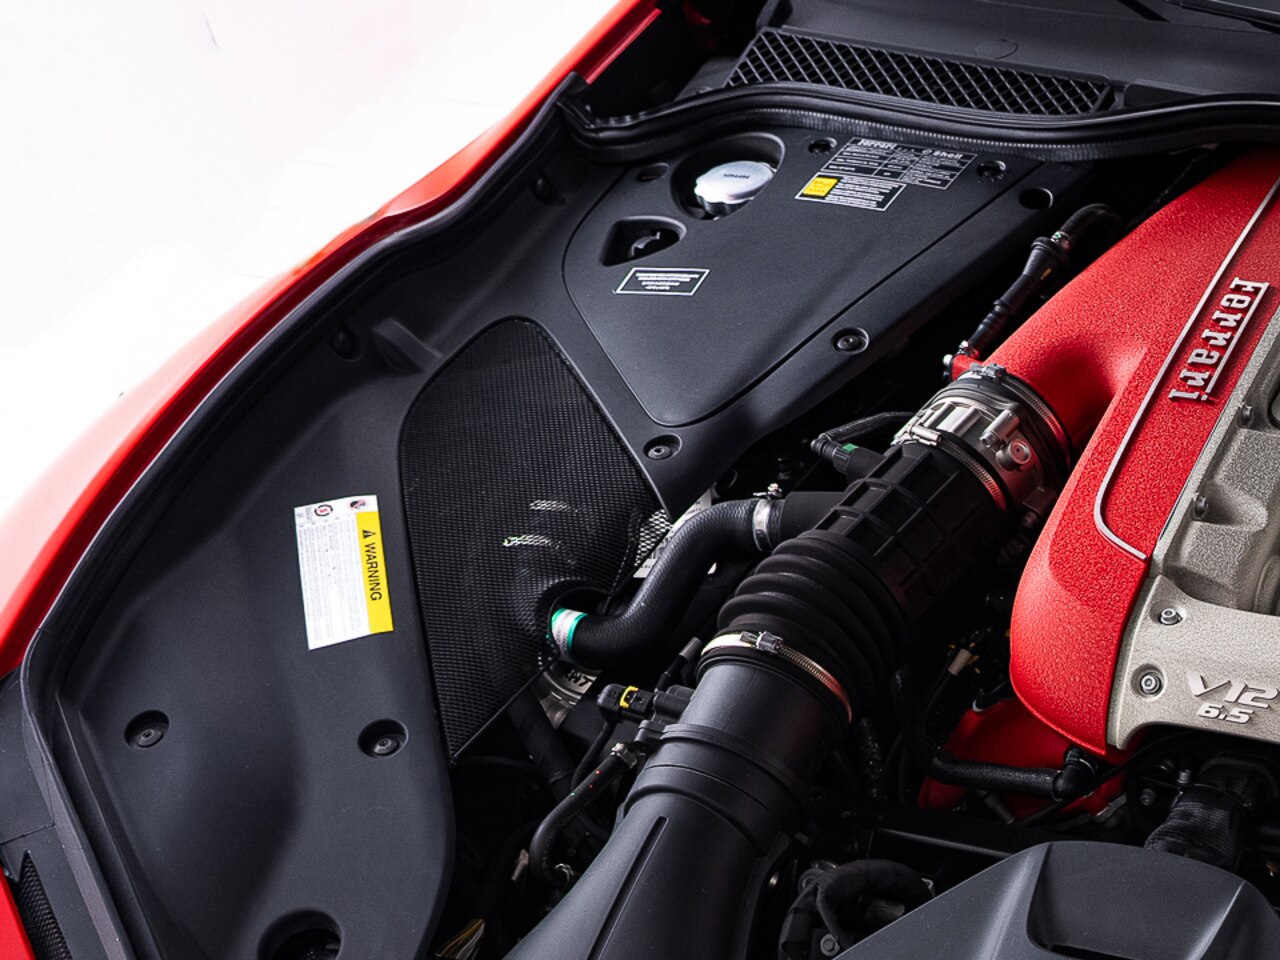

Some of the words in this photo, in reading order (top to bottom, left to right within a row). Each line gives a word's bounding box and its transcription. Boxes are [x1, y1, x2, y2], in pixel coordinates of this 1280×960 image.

[1168, 277, 1270, 402] Ferrari
[364, 542, 382, 601] WARNING
[1186, 671, 1280, 709] V12
[1197, 704, 1255, 724] 6.5
